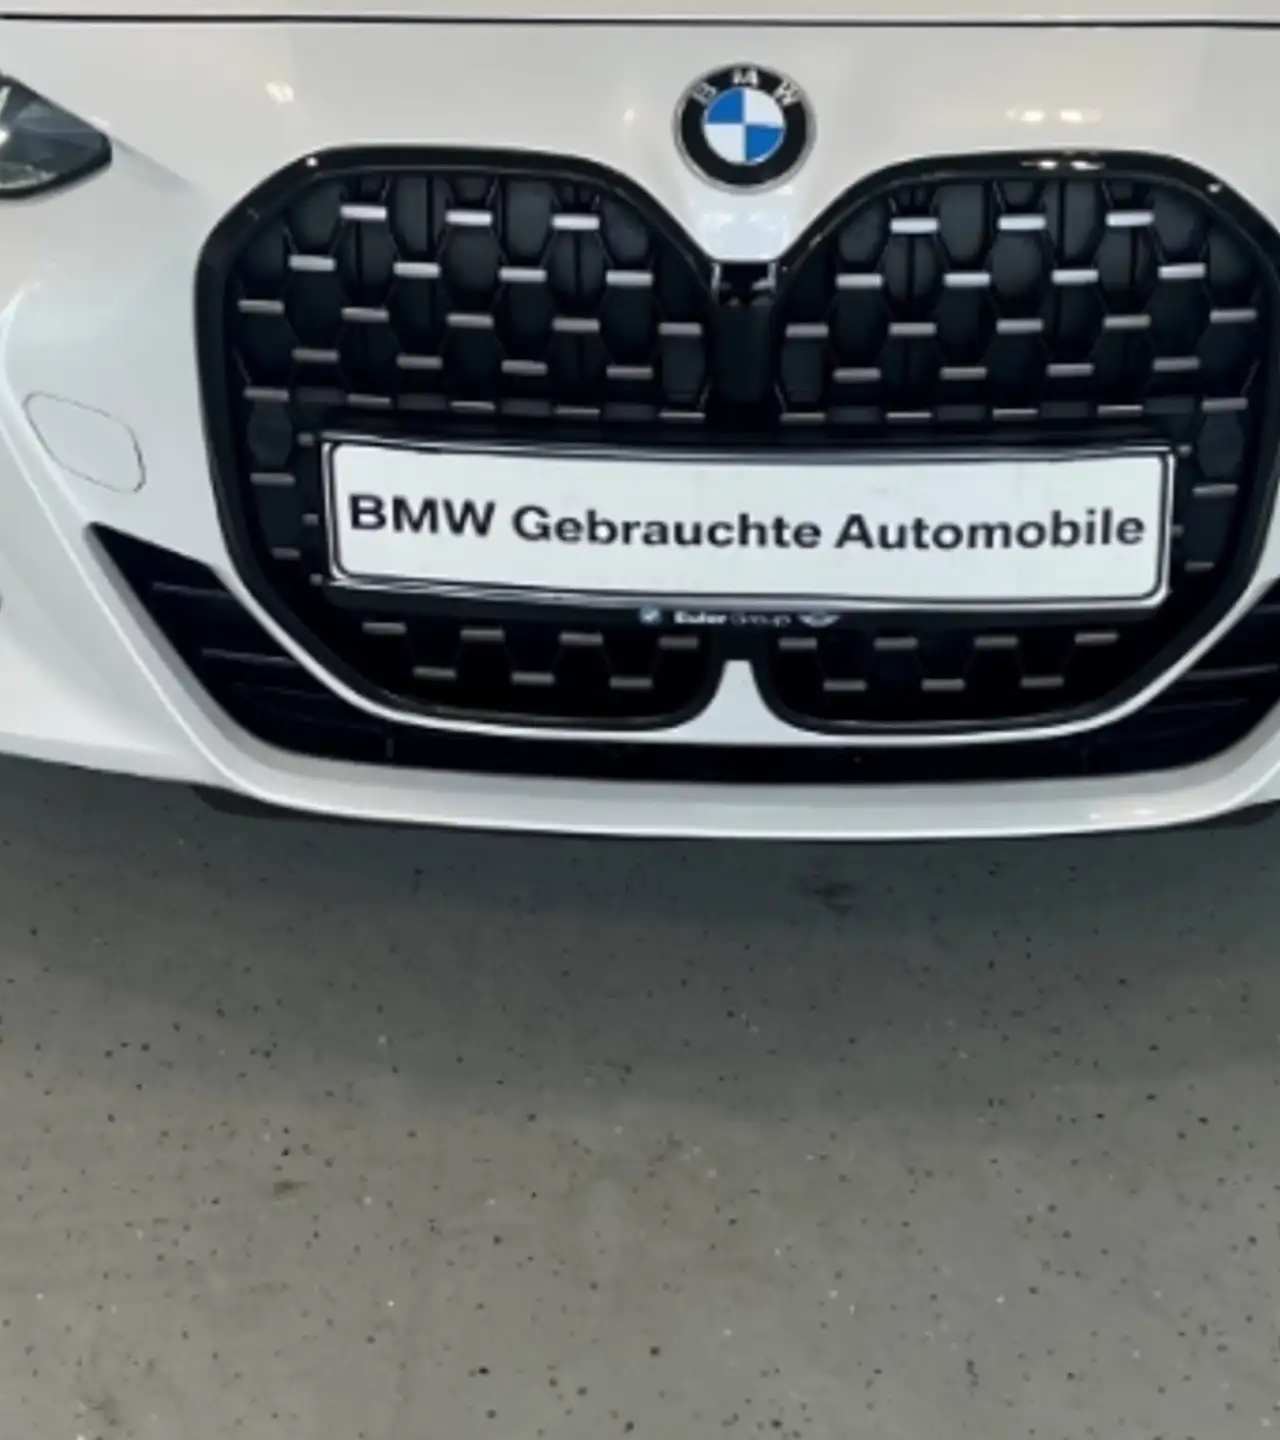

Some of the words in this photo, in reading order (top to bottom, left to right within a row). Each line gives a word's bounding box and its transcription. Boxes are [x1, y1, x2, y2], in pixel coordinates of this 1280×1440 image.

[349, 493, 496, 537] BMW
[512, 505, 822, 549] Gebrauchte
[834, 508, 1146, 550] Automobile
[673, 610, 727, 625] Euler
